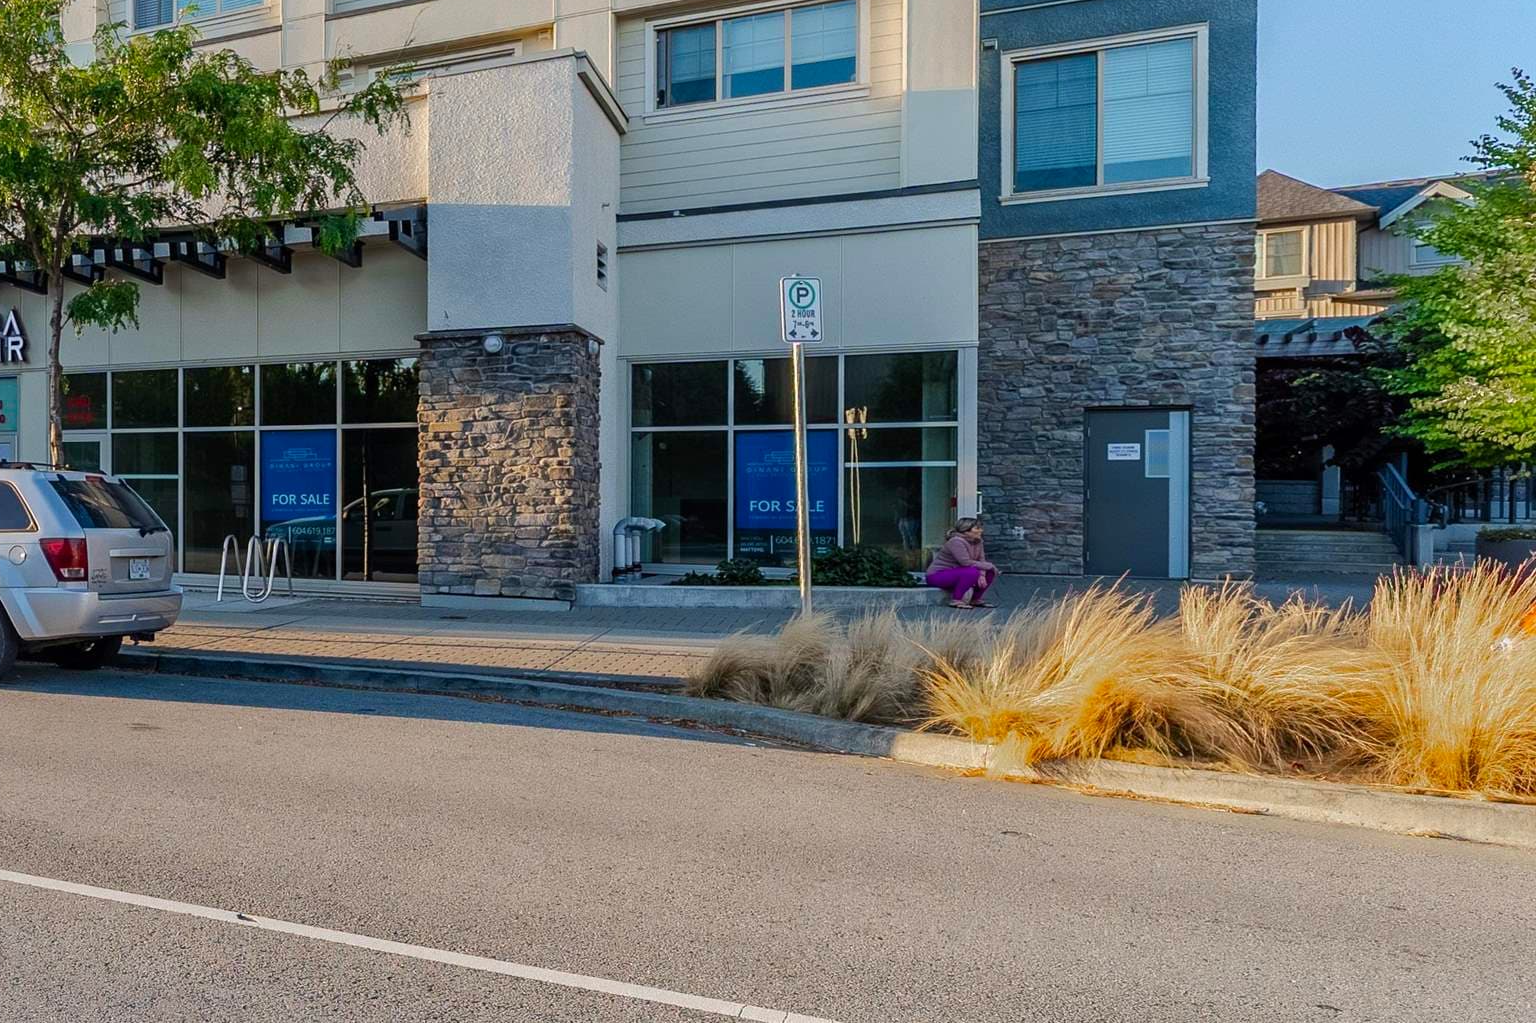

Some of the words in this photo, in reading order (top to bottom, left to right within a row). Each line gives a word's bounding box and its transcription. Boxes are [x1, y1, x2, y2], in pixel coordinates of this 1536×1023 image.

[796, 286, 809, 304] P
[791, 309, 796, 318] 2
[797, 309, 816, 318] HOUR
[272, 494, 296, 505] FOR
[300, 494, 330, 505] SALE
[749, 500, 781, 512] FOR
[785, 500, 825, 512] SE
